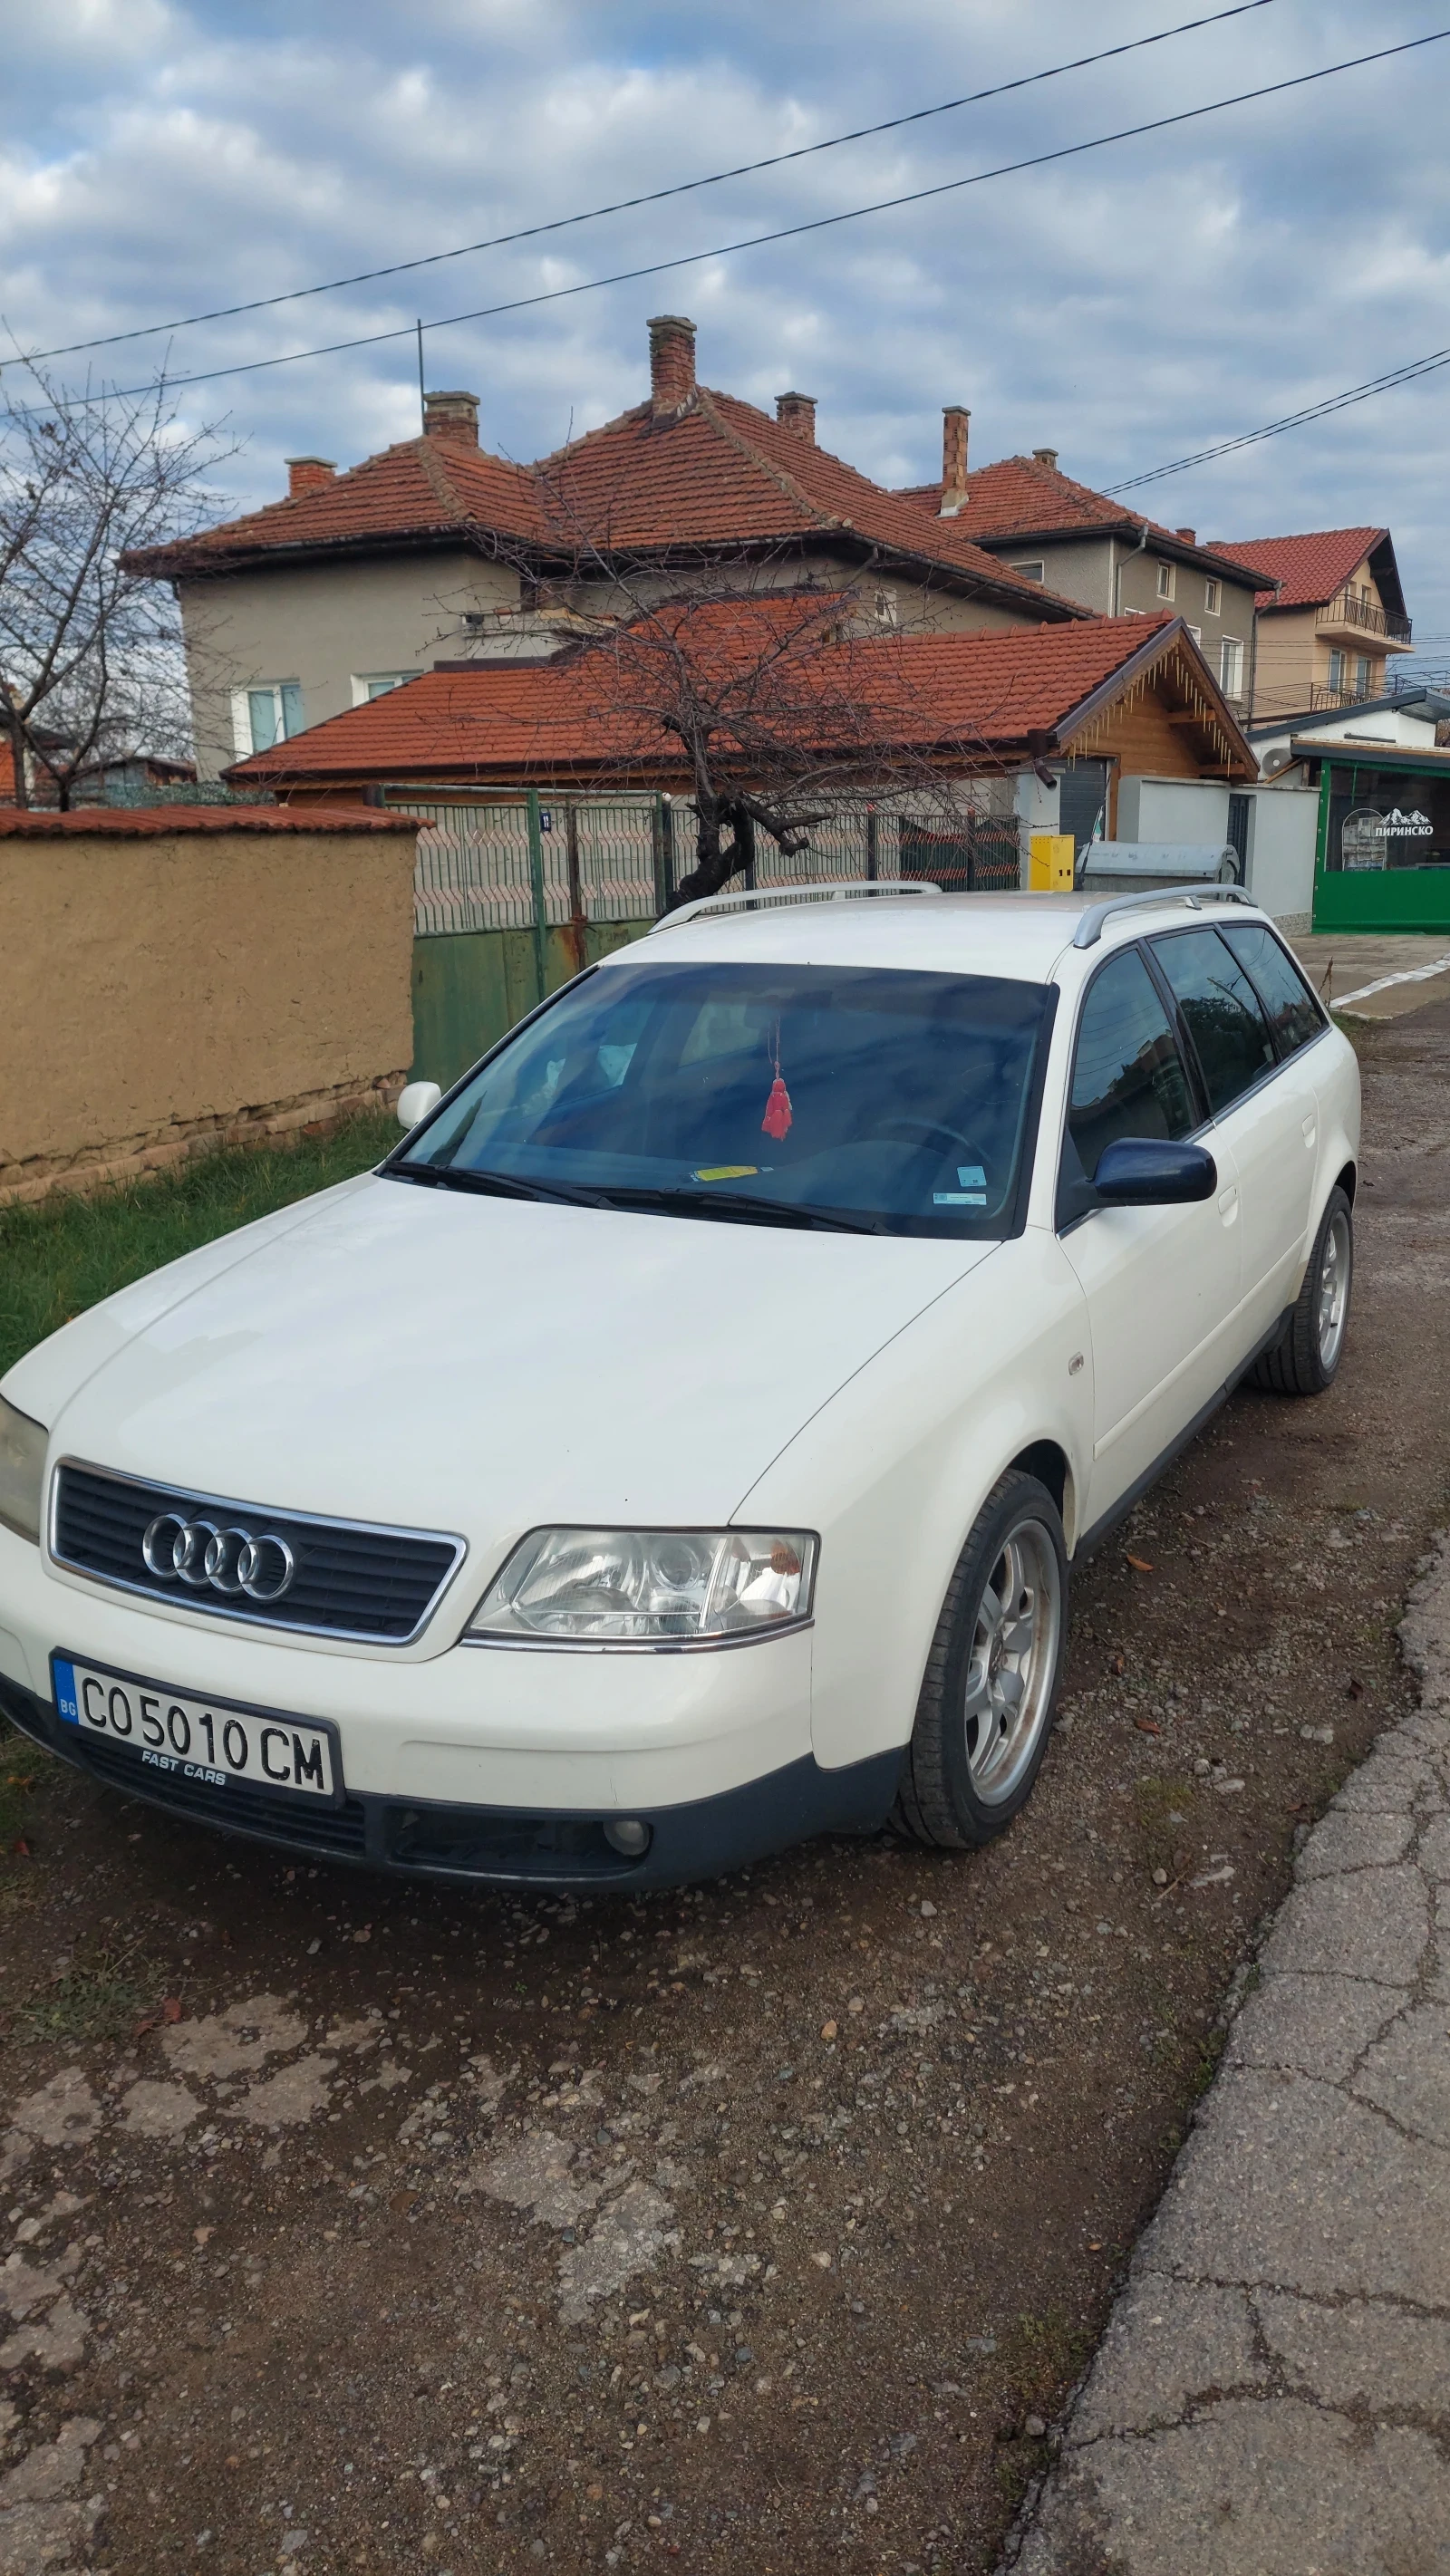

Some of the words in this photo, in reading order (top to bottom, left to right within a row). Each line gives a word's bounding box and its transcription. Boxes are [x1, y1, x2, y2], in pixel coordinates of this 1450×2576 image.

[1375, 825, 1434, 836] ПИРИНСКО
[60, 1698, 76, 1717] BG
[141, 1750, 179, 1771] FAST
[183, 1763, 226, 1786] CARS
